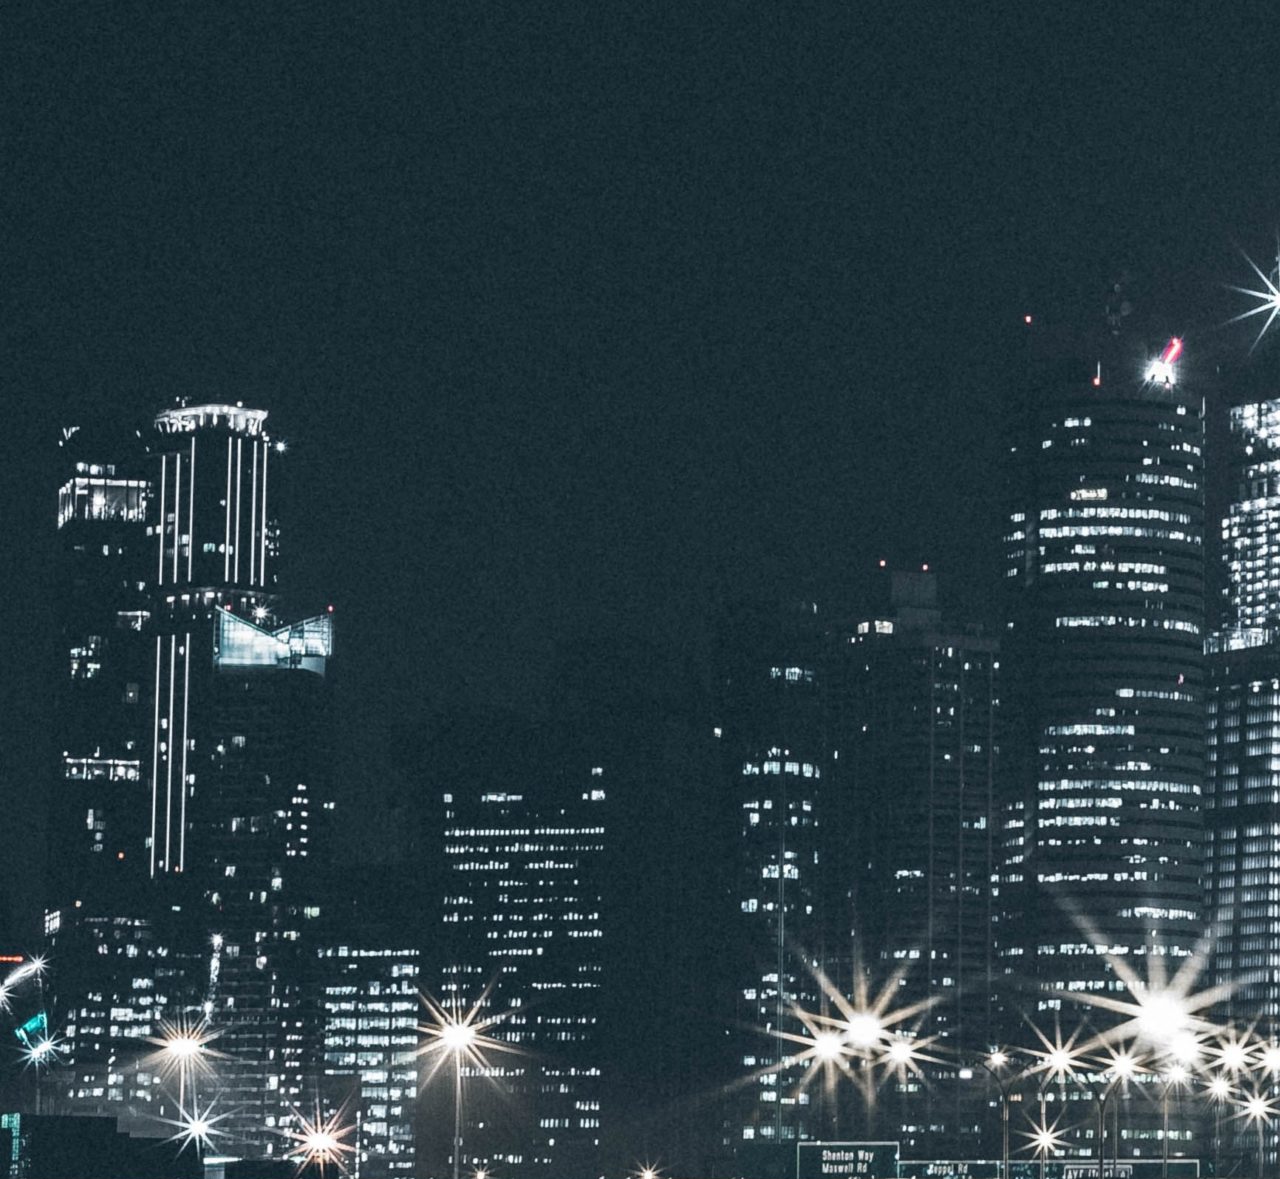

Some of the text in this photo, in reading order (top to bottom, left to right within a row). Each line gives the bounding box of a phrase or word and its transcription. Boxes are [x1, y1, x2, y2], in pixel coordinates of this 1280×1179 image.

[822, 1150, 875, 1163] Shenton Way
[822, 1162, 868, 1174] Maxwell Rd
[958, 1163, 968, 1174] Rd
